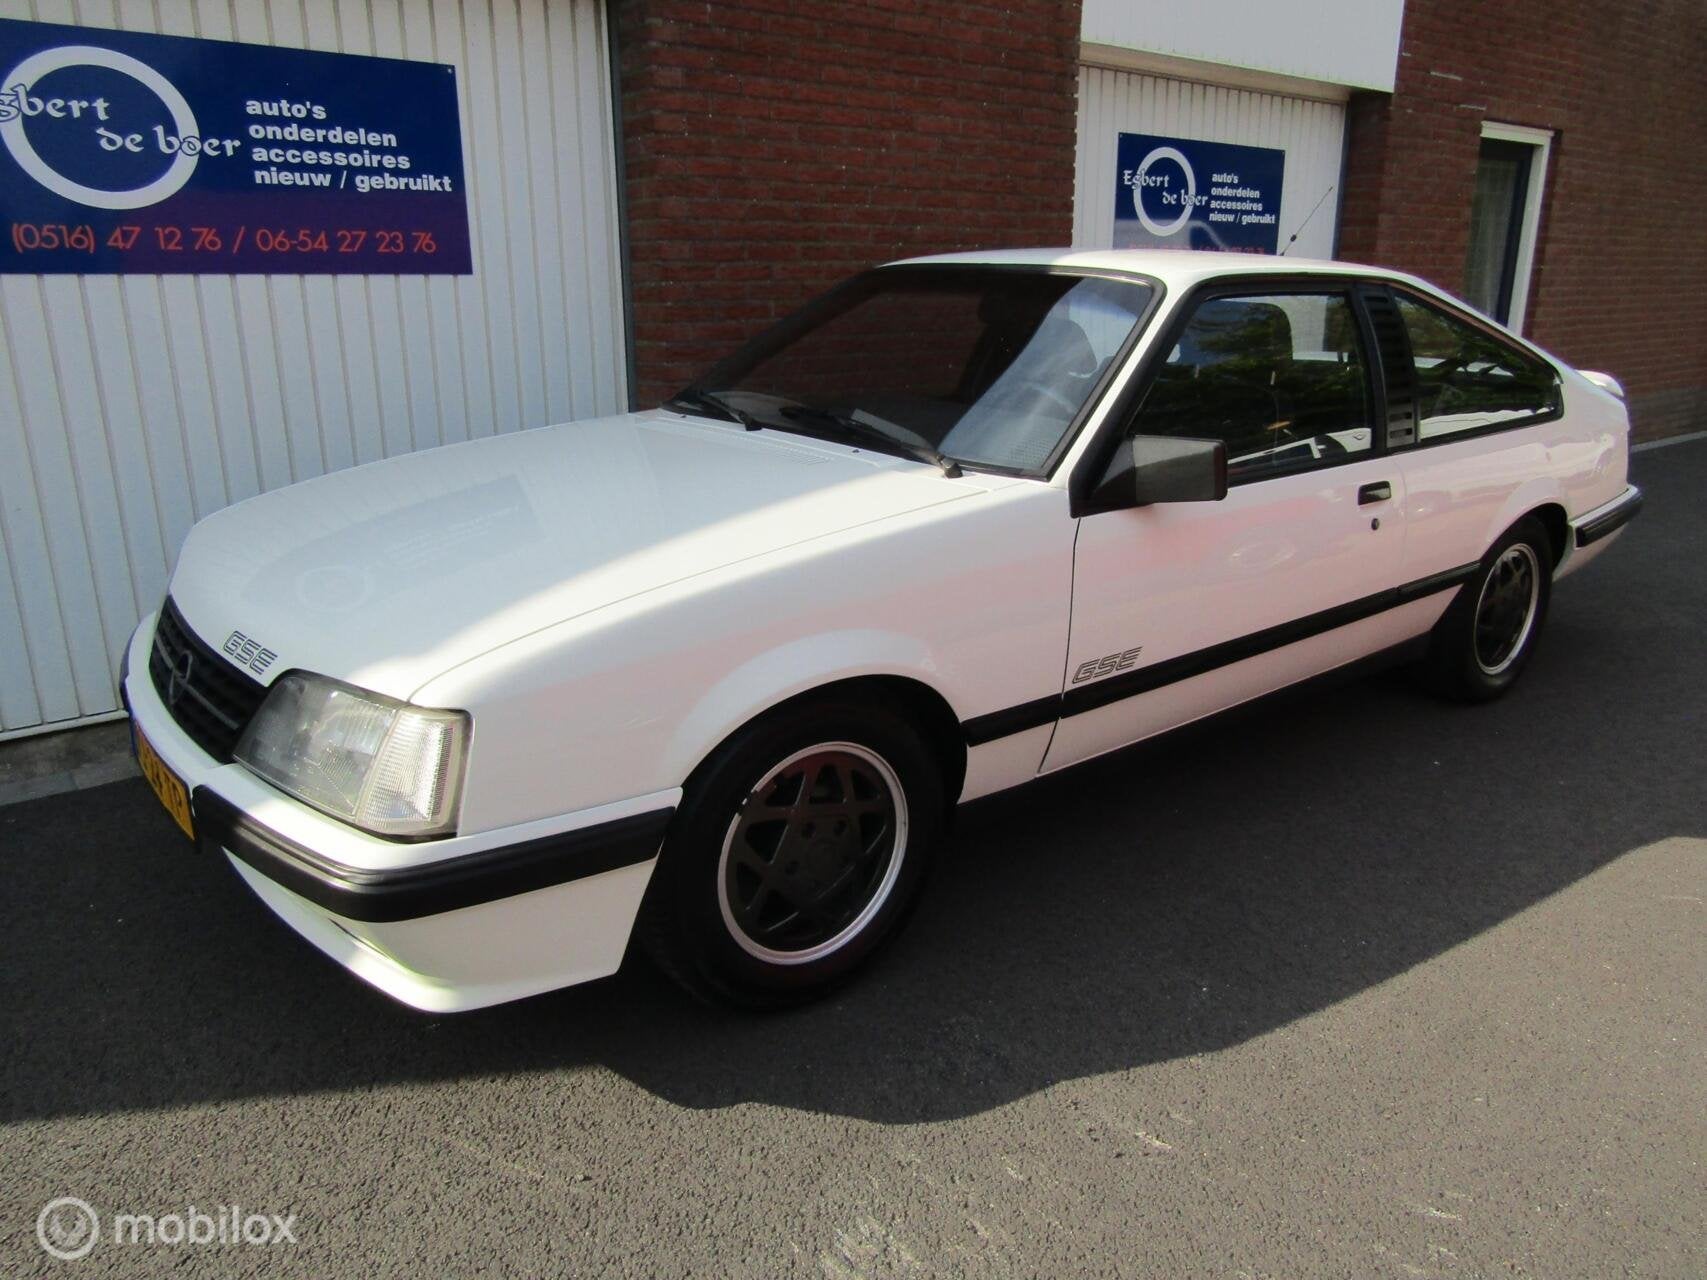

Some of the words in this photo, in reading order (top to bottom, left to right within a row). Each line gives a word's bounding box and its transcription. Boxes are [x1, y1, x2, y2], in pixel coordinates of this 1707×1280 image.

[0, 83, 110, 122] gbert
[246, 98, 327, 120] auto's
[96, 126, 143, 153] de
[153, 125, 241, 158] boer
[248, 122, 398, 148] onderdelen
[252, 145, 411, 170] accessoires
[254, 168, 332, 189] nieuw
[338, 170, 347, 191] /
[354, 172, 453, 194] gebruikt
[1123, 168, 1170, 190] Egbert
[1212, 172, 1239, 184] auto's
[1162, 191, 1178, 205] de
[1180, 189, 1208, 207] boer
[1211, 186, 1260, 199] onderdelen
[1209, 211, 1235, 223] nieuw
[1241, 212, 1276, 225] gebruikt
[1210, 199, 1263, 212] accessoires
[12, 222, 95, 254] (0516)
[107, 225, 141, 251] 47
[154, 226, 183, 251] 12
[191, 226, 221, 252] 76
[232, 225, 246, 253] /
[256, 228, 329, 254] 06-54
[336, 230, 367, 253] 27
[375, 230, 405, 253] 23
[412, 231, 437, 254] 76
[223, 630, 279, 676] GSE
[1071, 646, 1143, 685] GSE
